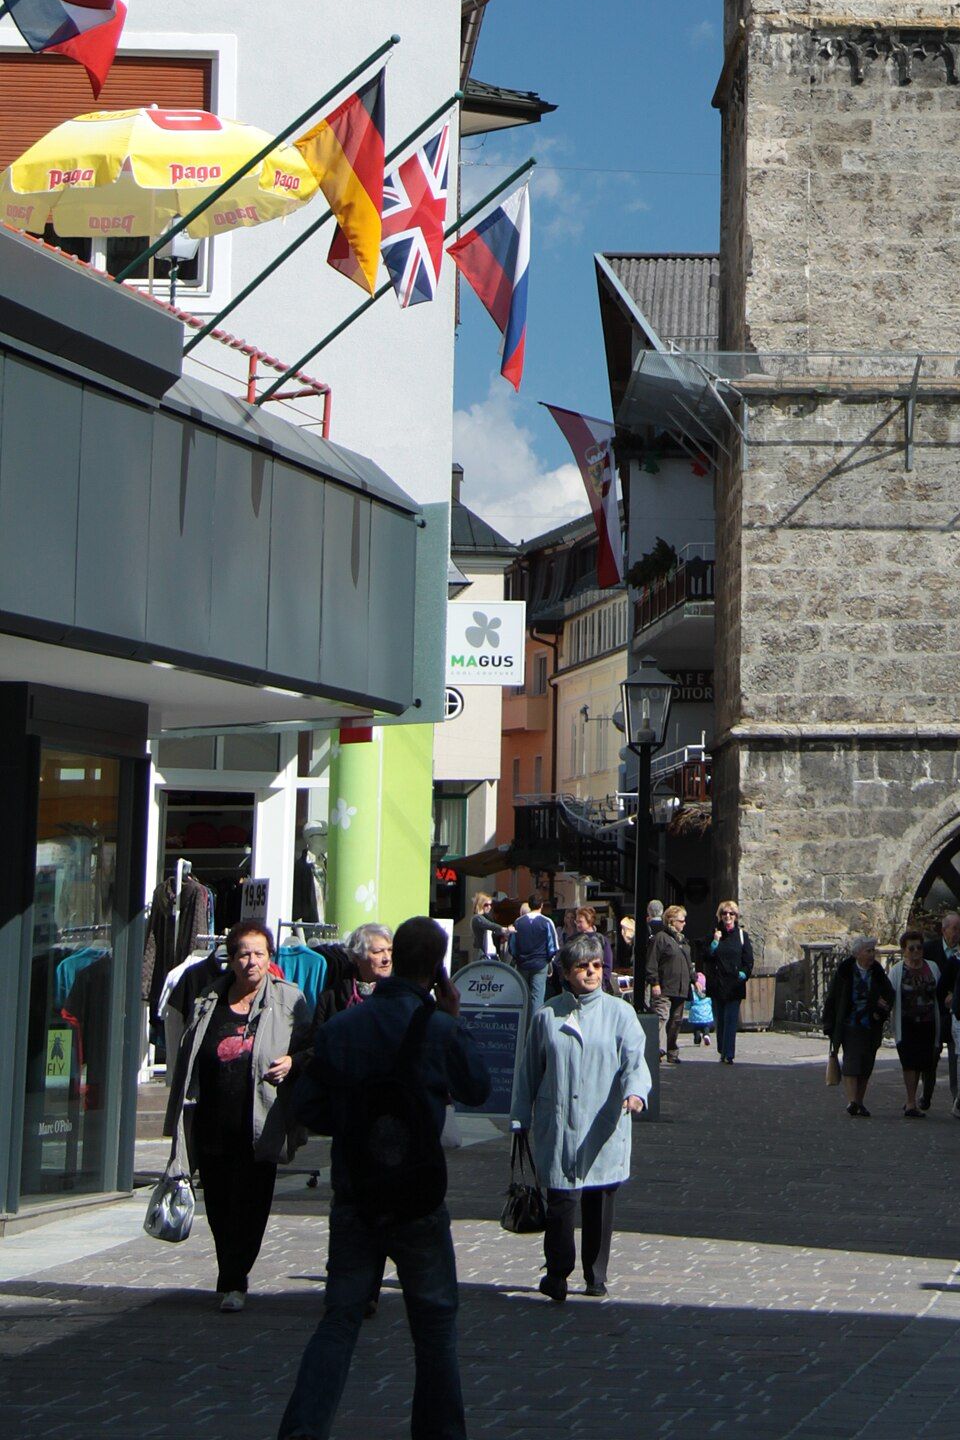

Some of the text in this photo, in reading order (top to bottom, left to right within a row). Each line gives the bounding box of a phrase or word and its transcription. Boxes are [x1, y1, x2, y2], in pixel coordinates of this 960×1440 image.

[451, 655, 514, 667] MAGUS
[244, 884, 267, 911] 19,95
[468, 980, 504, 994] Zipfer
[47, 1062, 65, 1075] FLY
